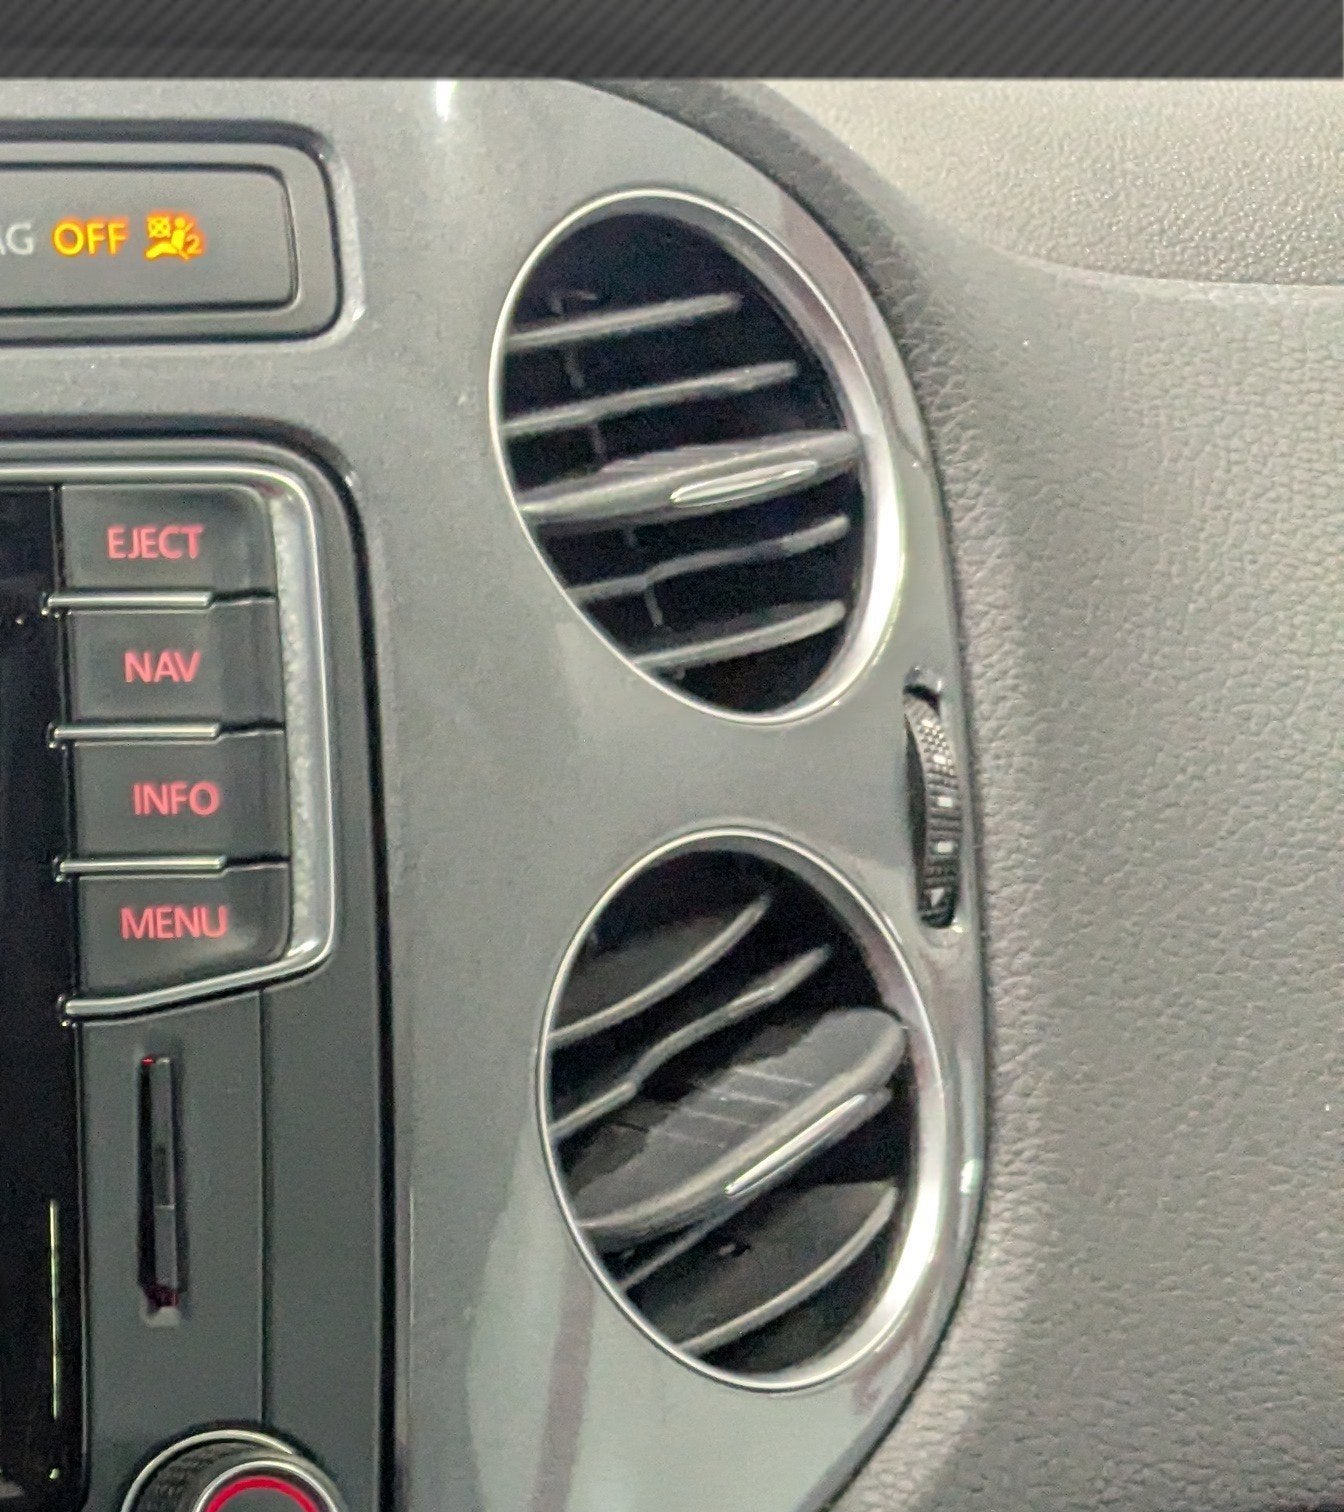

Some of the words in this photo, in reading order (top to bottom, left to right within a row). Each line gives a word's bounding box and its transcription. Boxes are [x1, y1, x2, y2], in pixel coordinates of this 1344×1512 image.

[52, 218, 129, 256] OFF
[106, 523, 204, 560] EJECT
[124, 650, 201, 683] NAV
[132, 782, 220, 816] INFO
[120, 906, 228, 941] MENU
